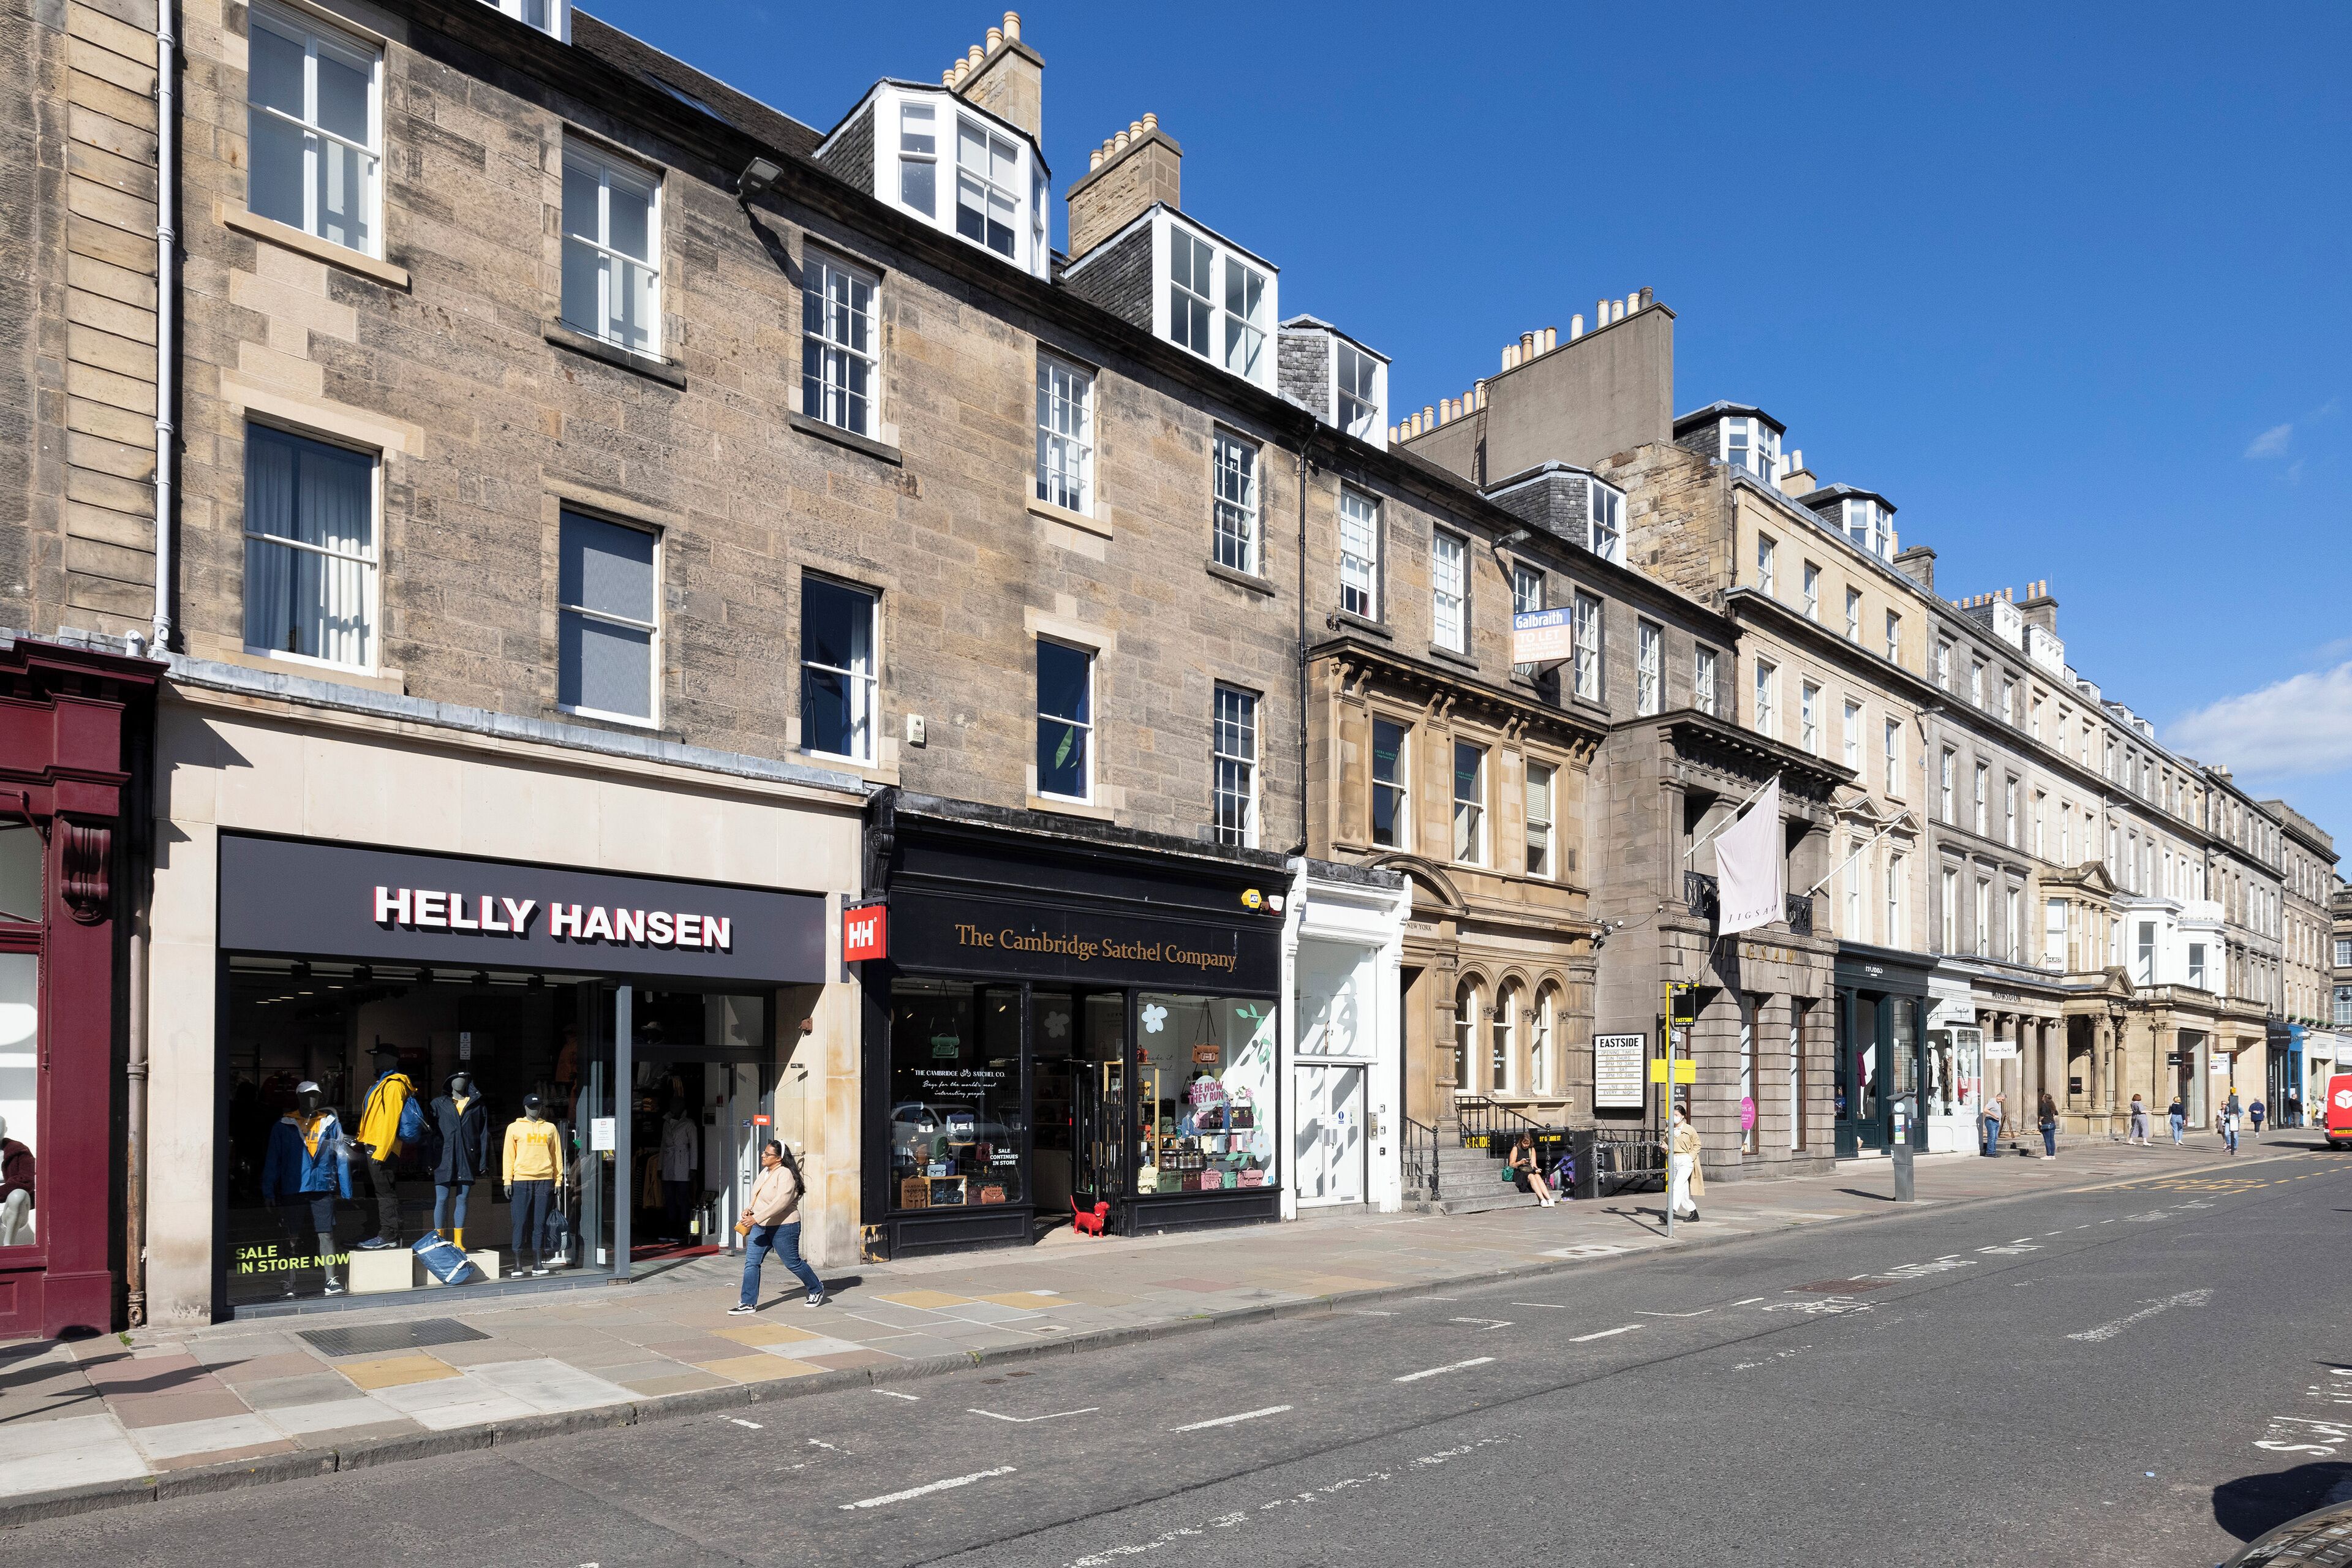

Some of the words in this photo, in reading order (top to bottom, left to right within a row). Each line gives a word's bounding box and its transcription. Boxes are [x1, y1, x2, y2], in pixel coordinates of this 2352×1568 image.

[1515, 611, 1563, 629] Galbraith
[1518, 632, 1535, 644] TO
[1538, 629, 1559, 642] LET
[374, 886, 537, 933] HELLY
[549, 902, 730, 949] HANSEN
[1727, 905, 1776, 924] JIGSAW
[955, 924, 995, 947] The
[1000, 929, 1098, 960] Cambridge
[1102, 938, 1161, 962] Satchel
[1165, 944, 1237, 973] Company
[1721, 939, 1796, 965] JIGSAW
[1865, 963, 1883, 974] HOBBS
[1600, 1038, 1639, 1047] EASTSIDE
[922, 1080, 938, 1089] Bags
[1189, 1084, 1202, 1095] SEE
[1204, 1080, 1224, 1092] HOW
[934, 1090, 967, 1098] interesting
[967, 1090, 986, 1098] people
[1188, 1093, 1208, 1104] THEY
[1210, 1090, 1224, 1102] RUN
[527, 1133, 548, 1144] HH
[235, 1245, 277, 1260] SALE
[236, 1262, 253, 1275] IN
[257, 1257, 310, 1273] STORE
[314, 1253, 350, 1267] NOW
